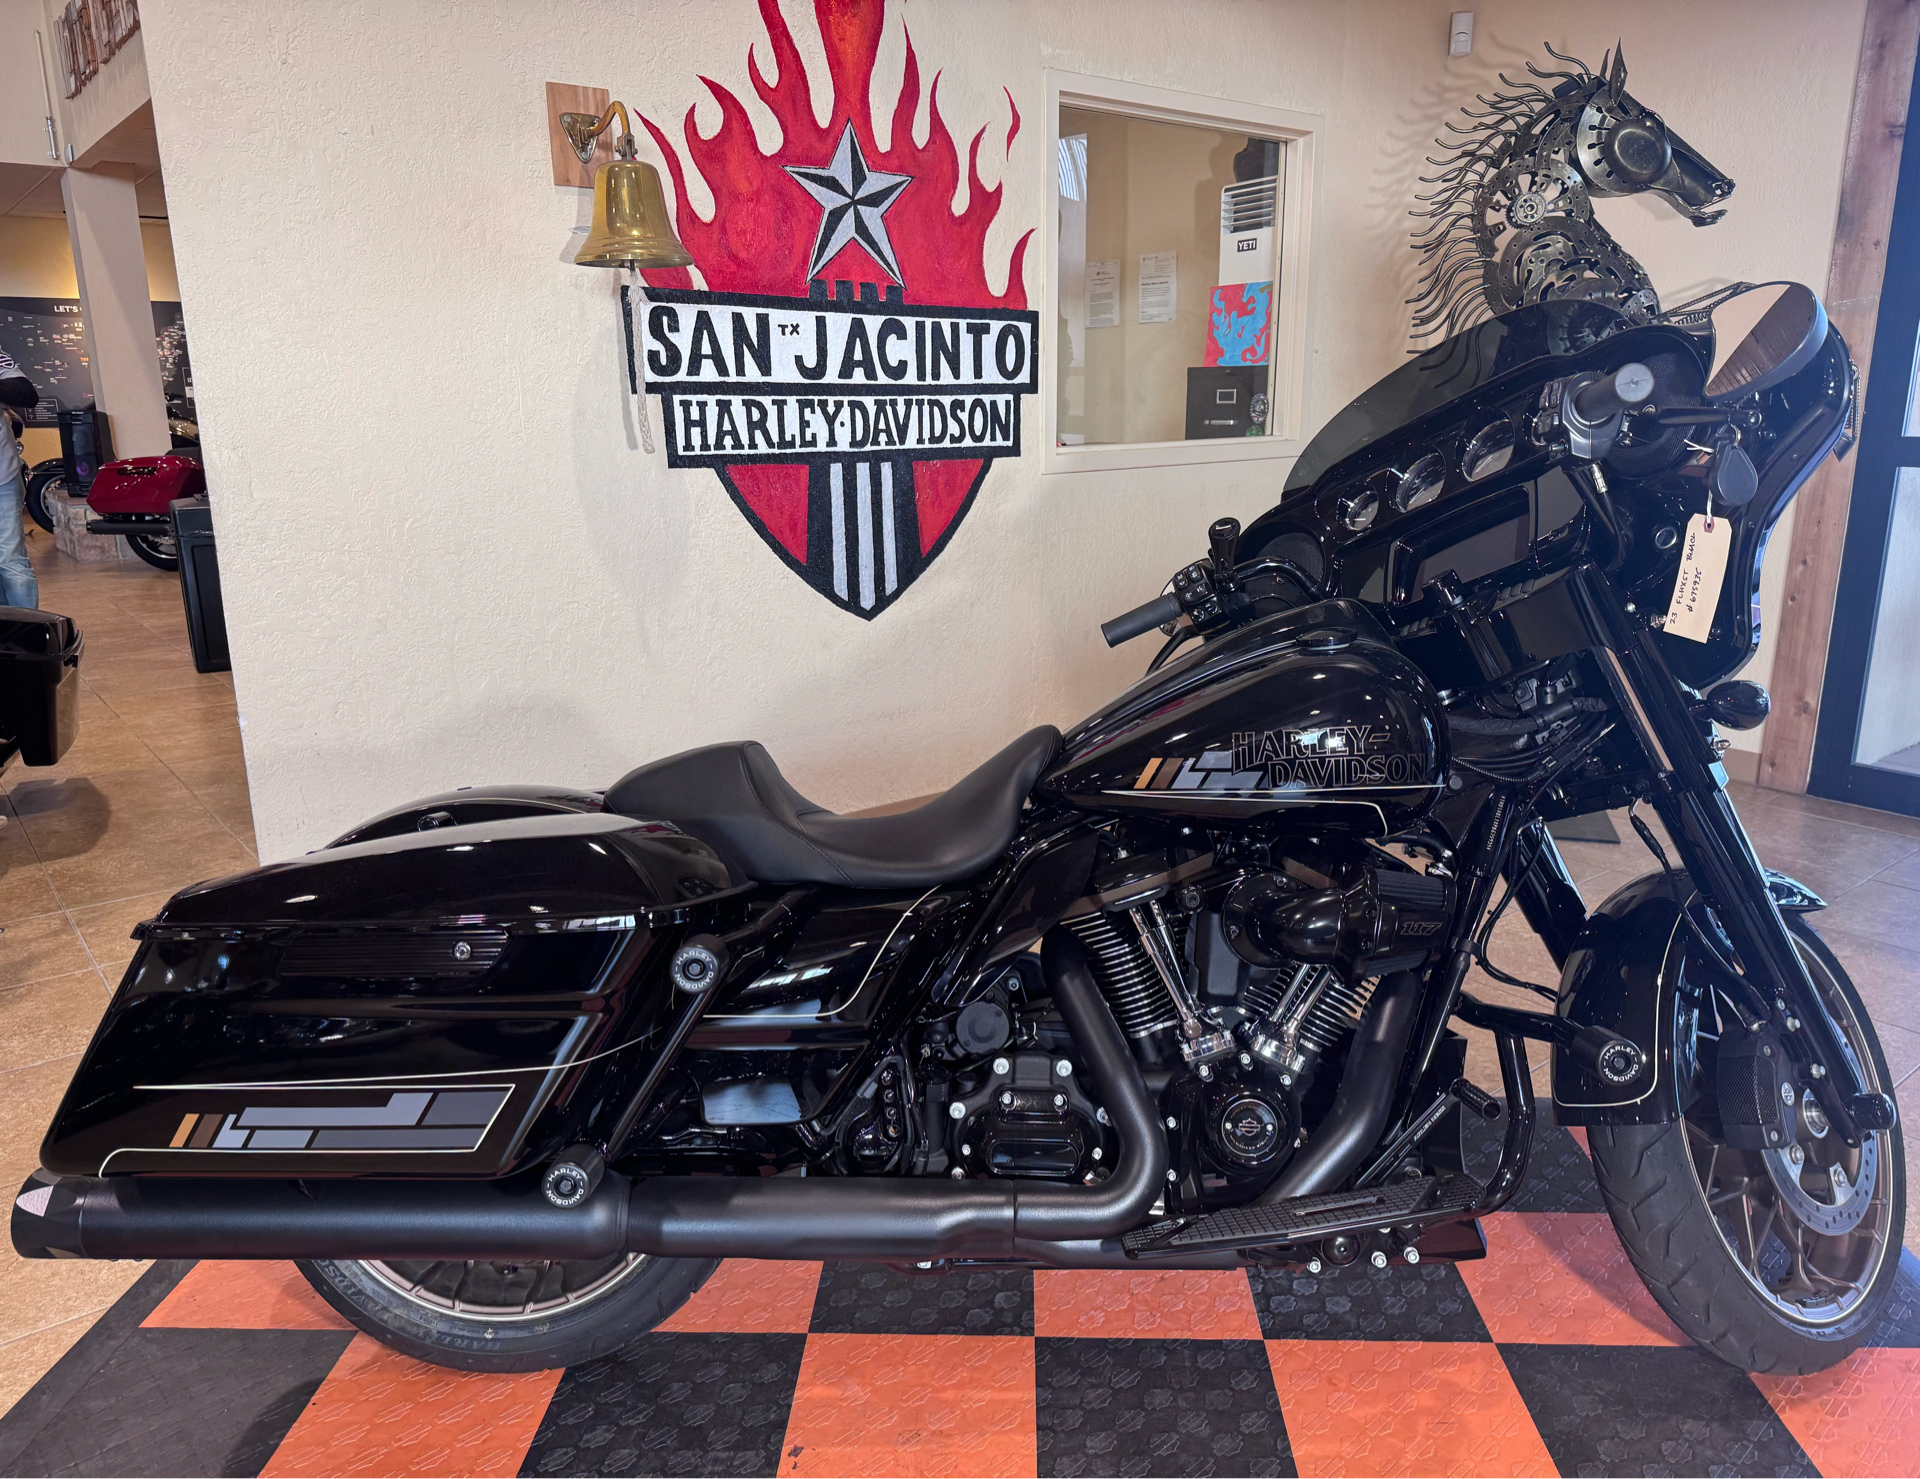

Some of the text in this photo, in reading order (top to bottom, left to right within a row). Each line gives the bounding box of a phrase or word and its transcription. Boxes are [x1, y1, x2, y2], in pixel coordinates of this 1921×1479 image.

[1238, 240, 1256, 251] YETI
[54, 305, 79, 313] LET'S
[646, 305, 1026, 382] SAN TX JACINTO
[1670, 612, 1678, 625] 23
[1267, 753, 1428, 788] DAVIDSON
[1400, 921, 1443, 936] 117
[675, 950, 714, 989] HARLEY DAVIDSON
[1604, 1045, 1638, 1082] HARLEY DAVIDSON
[546, 1167, 584, 1206] HARLEY DAVIDSON
